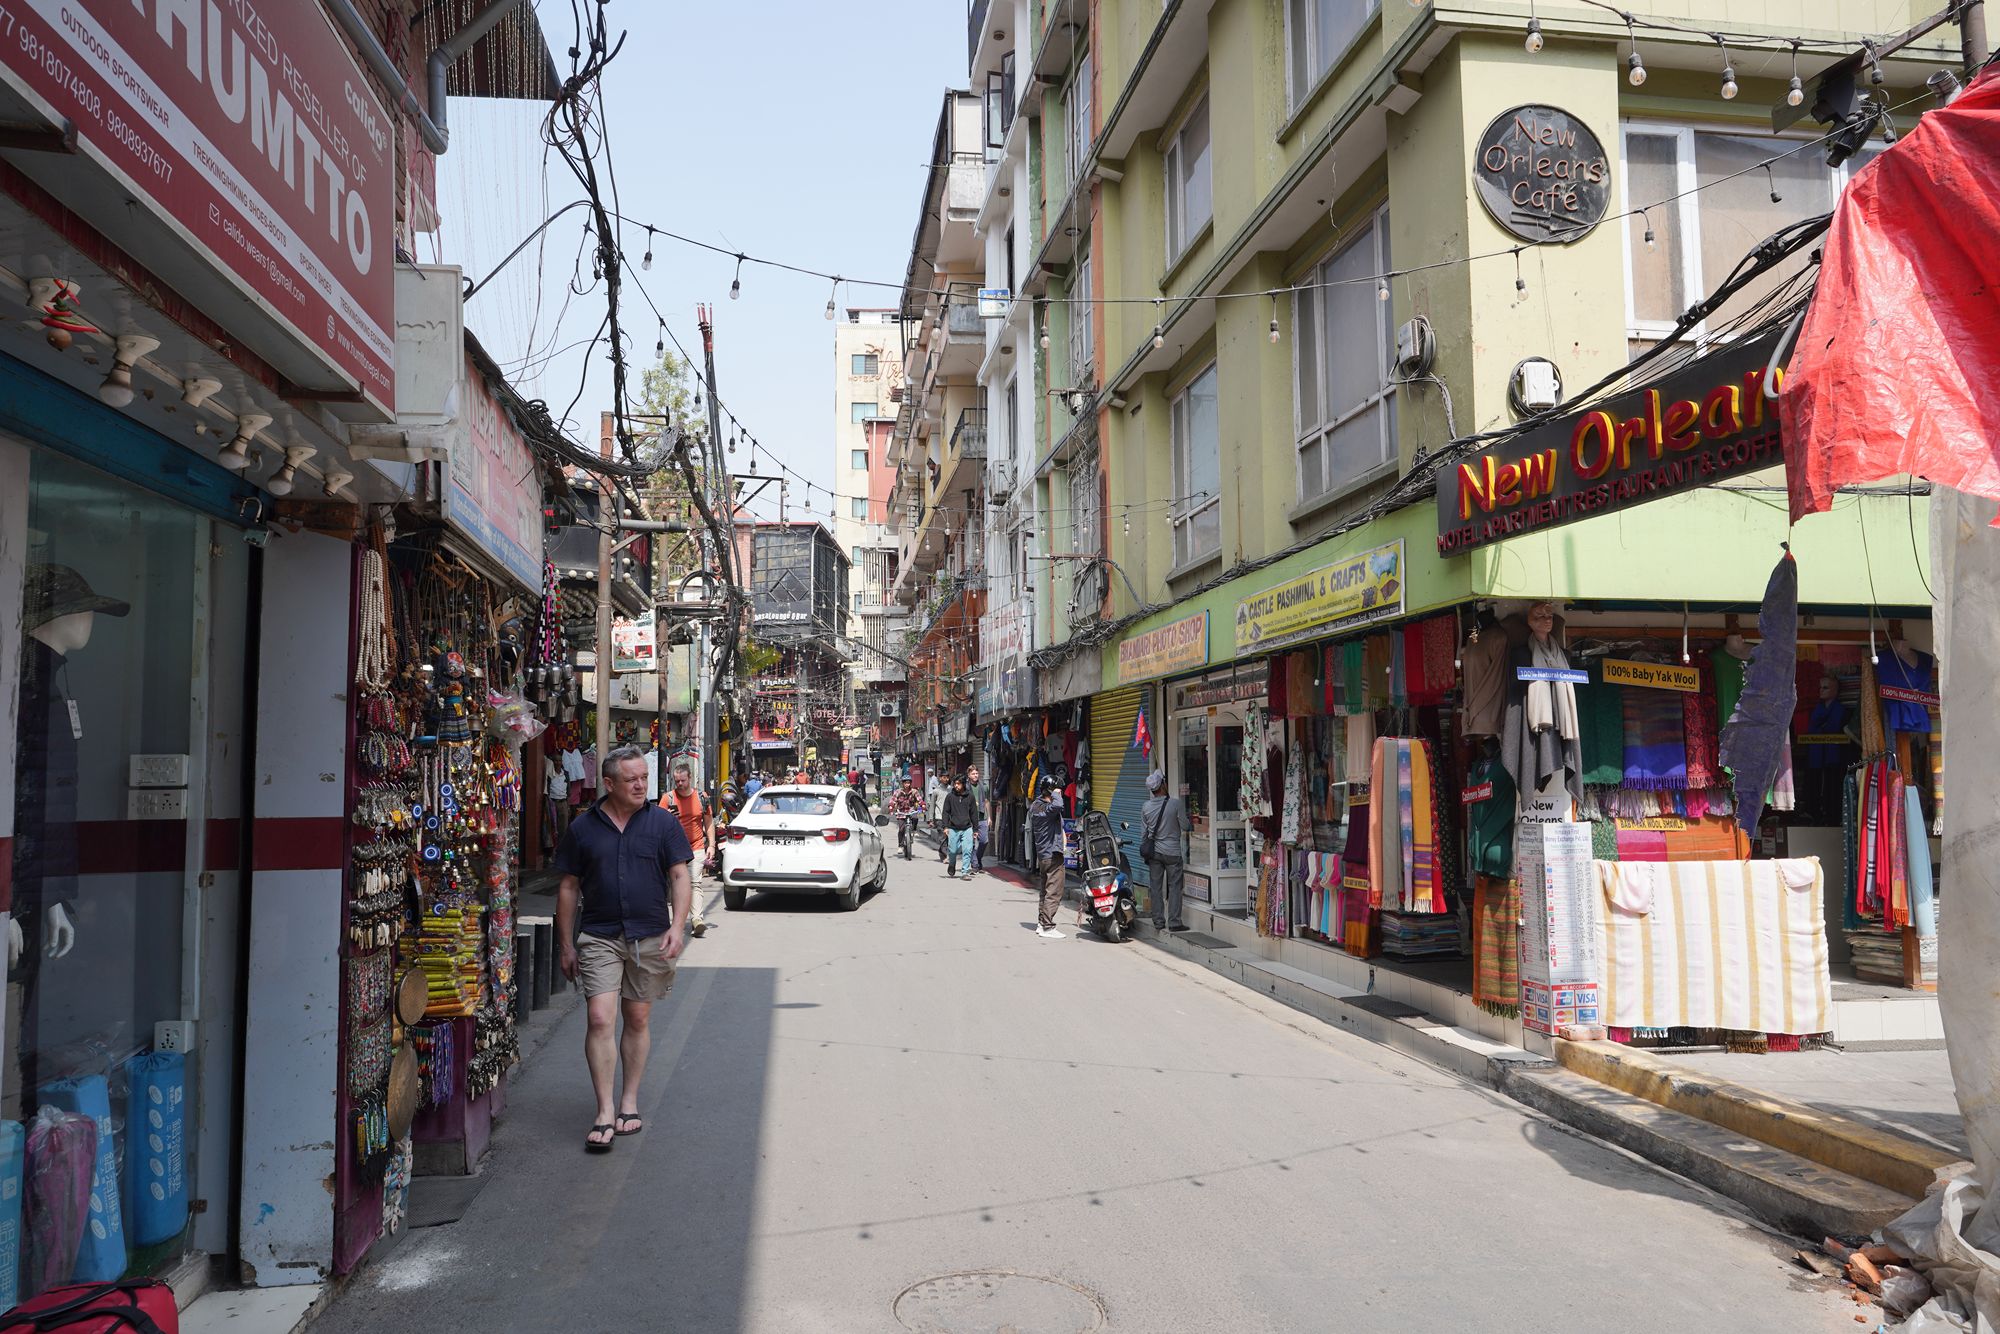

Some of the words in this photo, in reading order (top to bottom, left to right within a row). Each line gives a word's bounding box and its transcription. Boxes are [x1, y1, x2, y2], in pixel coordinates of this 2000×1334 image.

[61, 7, 110, 69] OUTDOOR
[111, 58, 170, 129] SPORTSWEAR
[19, 26, 104, 127] 9818074808,
[107, 110, 173, 184] 9808937677
[282, 53, 350, 168] RESELLER
[352, 153, 367, 187] OF
[344, 80, 383, 152] calido
[1514, 116, 1577, 148] New
[1484, 144, 1604, 184] Orleans
[1512, 181, 1579, 212] Café
[223, 217, 306, 306] calido.wears1@gmail.com
[1437, 528, 1480, 553] HOTEL
[1480, 497, 1571, 542] APARTMENT
[1572, 461, 1700, 514] RESTAURANT
[1701, 450, 1716, 476] &
[1716, 431, 1784, 470] COFF
[1457, 448, 1558, 521] New
[1249, 594, 1273, 621] CASTLE
[1276, 579, 1315, 611] PASHMINA
[1319, 575, 1326, 597] &
[1330, 561, 1366, 593] CRAFTS
[1179, 615, 1202, 646] SHOP
[1606, 664, 1631, 678] 100%
[1632, 667, 1654, 683] Baby
[1655, 669, 1672, 683] Yak
[1673, 672, 1696, 686] Wool
[1528, 800, 1553, 811] New
[1663, 818, 1684, 829] SHAWLS
[1536, 991, 1548, 1004] VISA
[1576, 993, 1596, 1004] VISA
